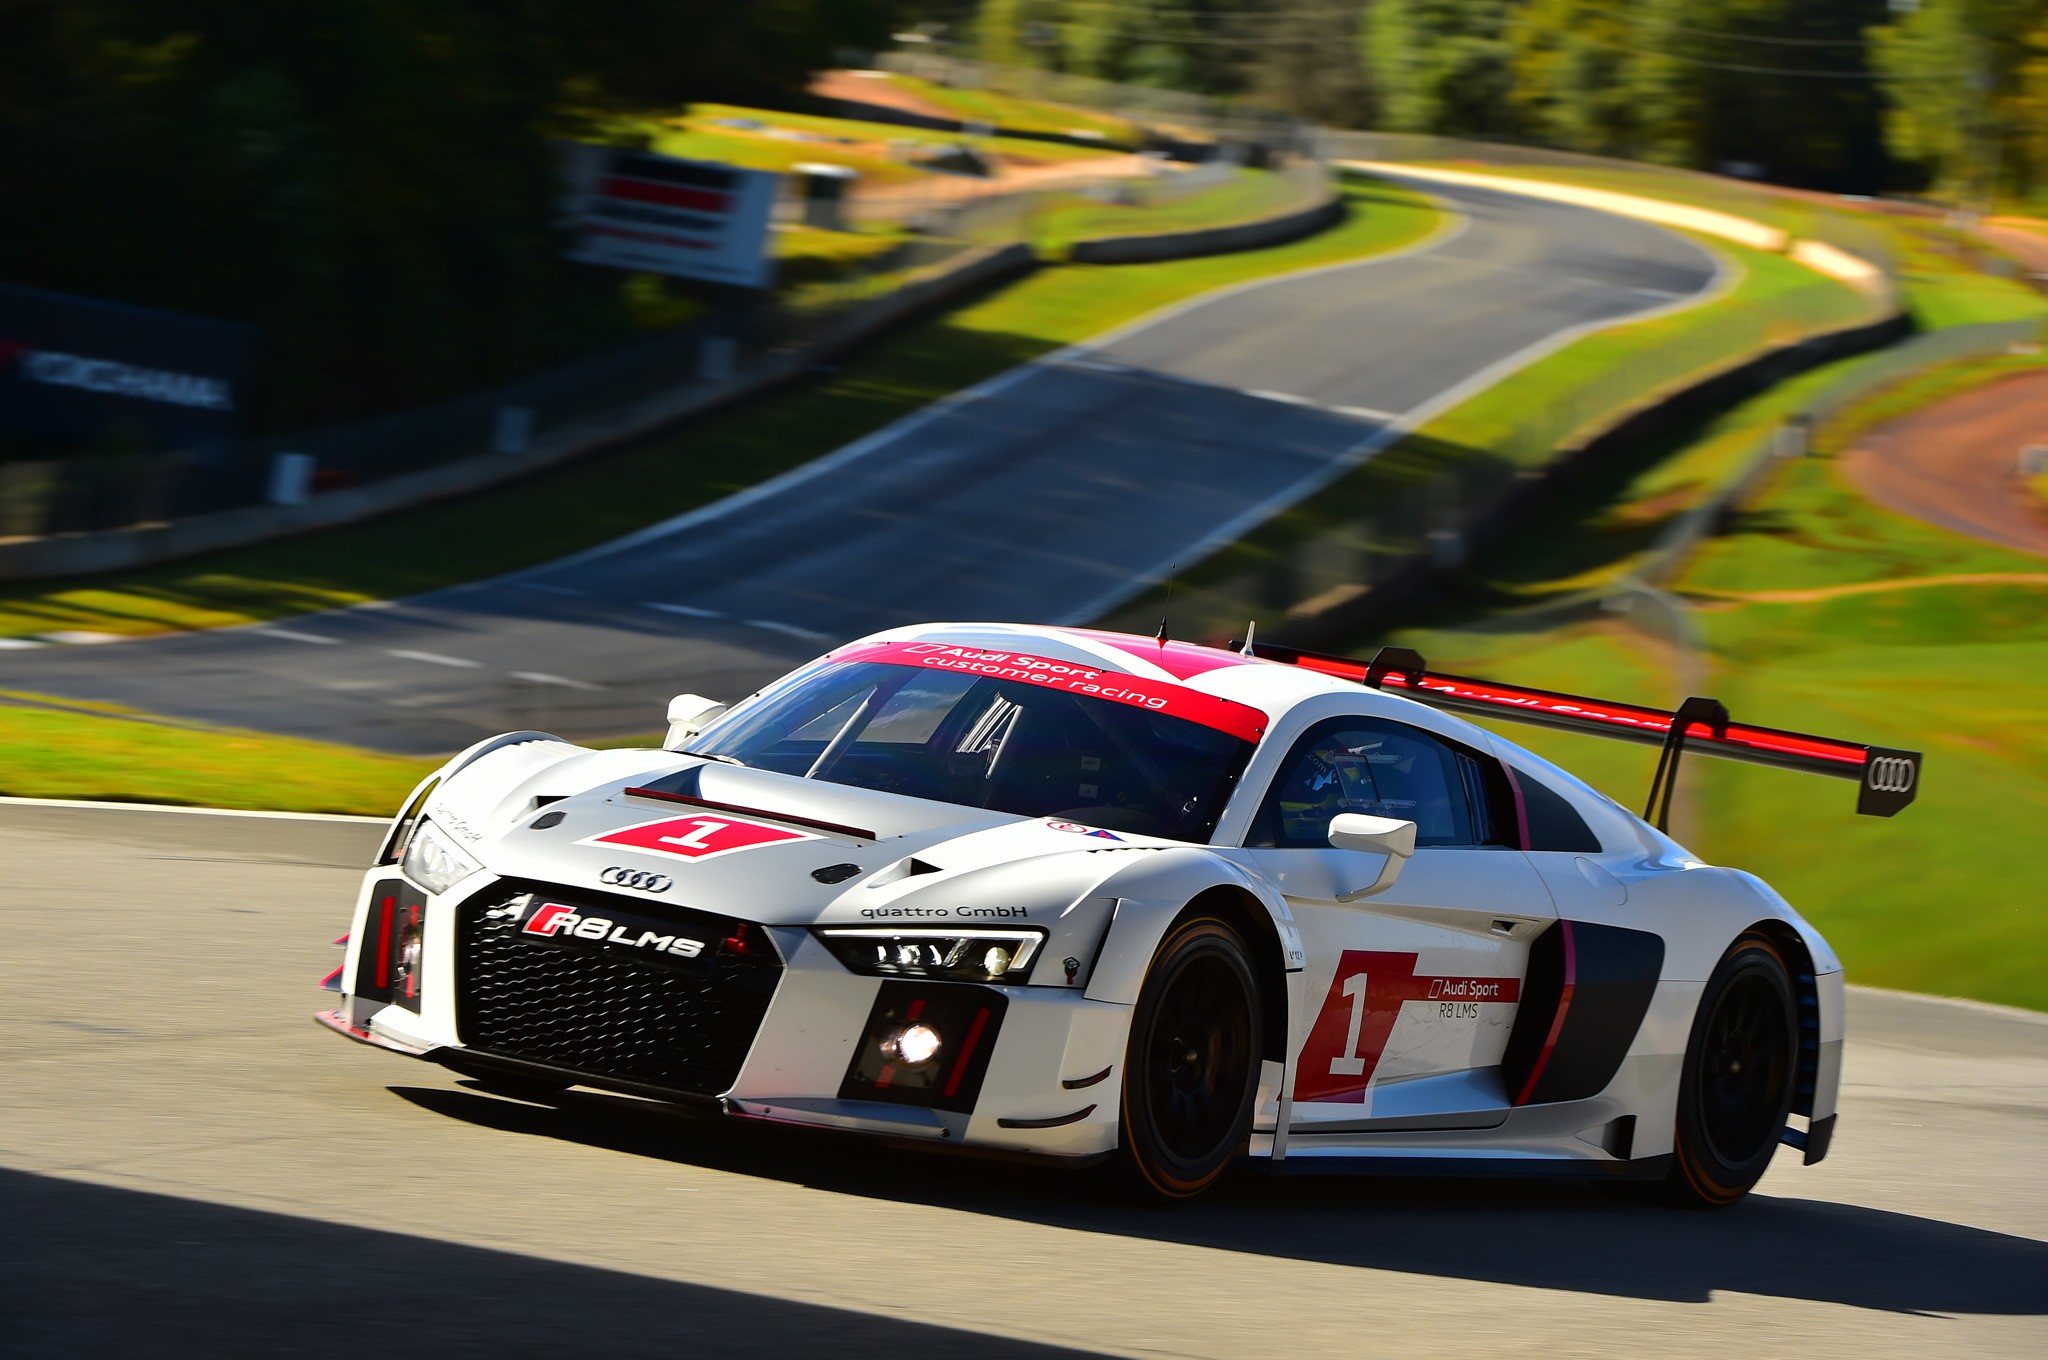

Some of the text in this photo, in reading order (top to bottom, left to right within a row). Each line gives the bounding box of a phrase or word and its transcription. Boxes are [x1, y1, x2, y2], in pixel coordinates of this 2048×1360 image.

[938, 648, 1100, 680] Audi Sport
[922, 655, 1169, 710] customer racing
[657, 820, 730, 850] 1
[861, 905, 1028, 920] quattro GmbH
[543, 911, 706, 958] R8 LMS
[1442, 979, 1499, 1000] Audi Sport
[1328, 972, 1368, 1076] 1
[1438, 1002, 1479, 1019] R8 LMS
